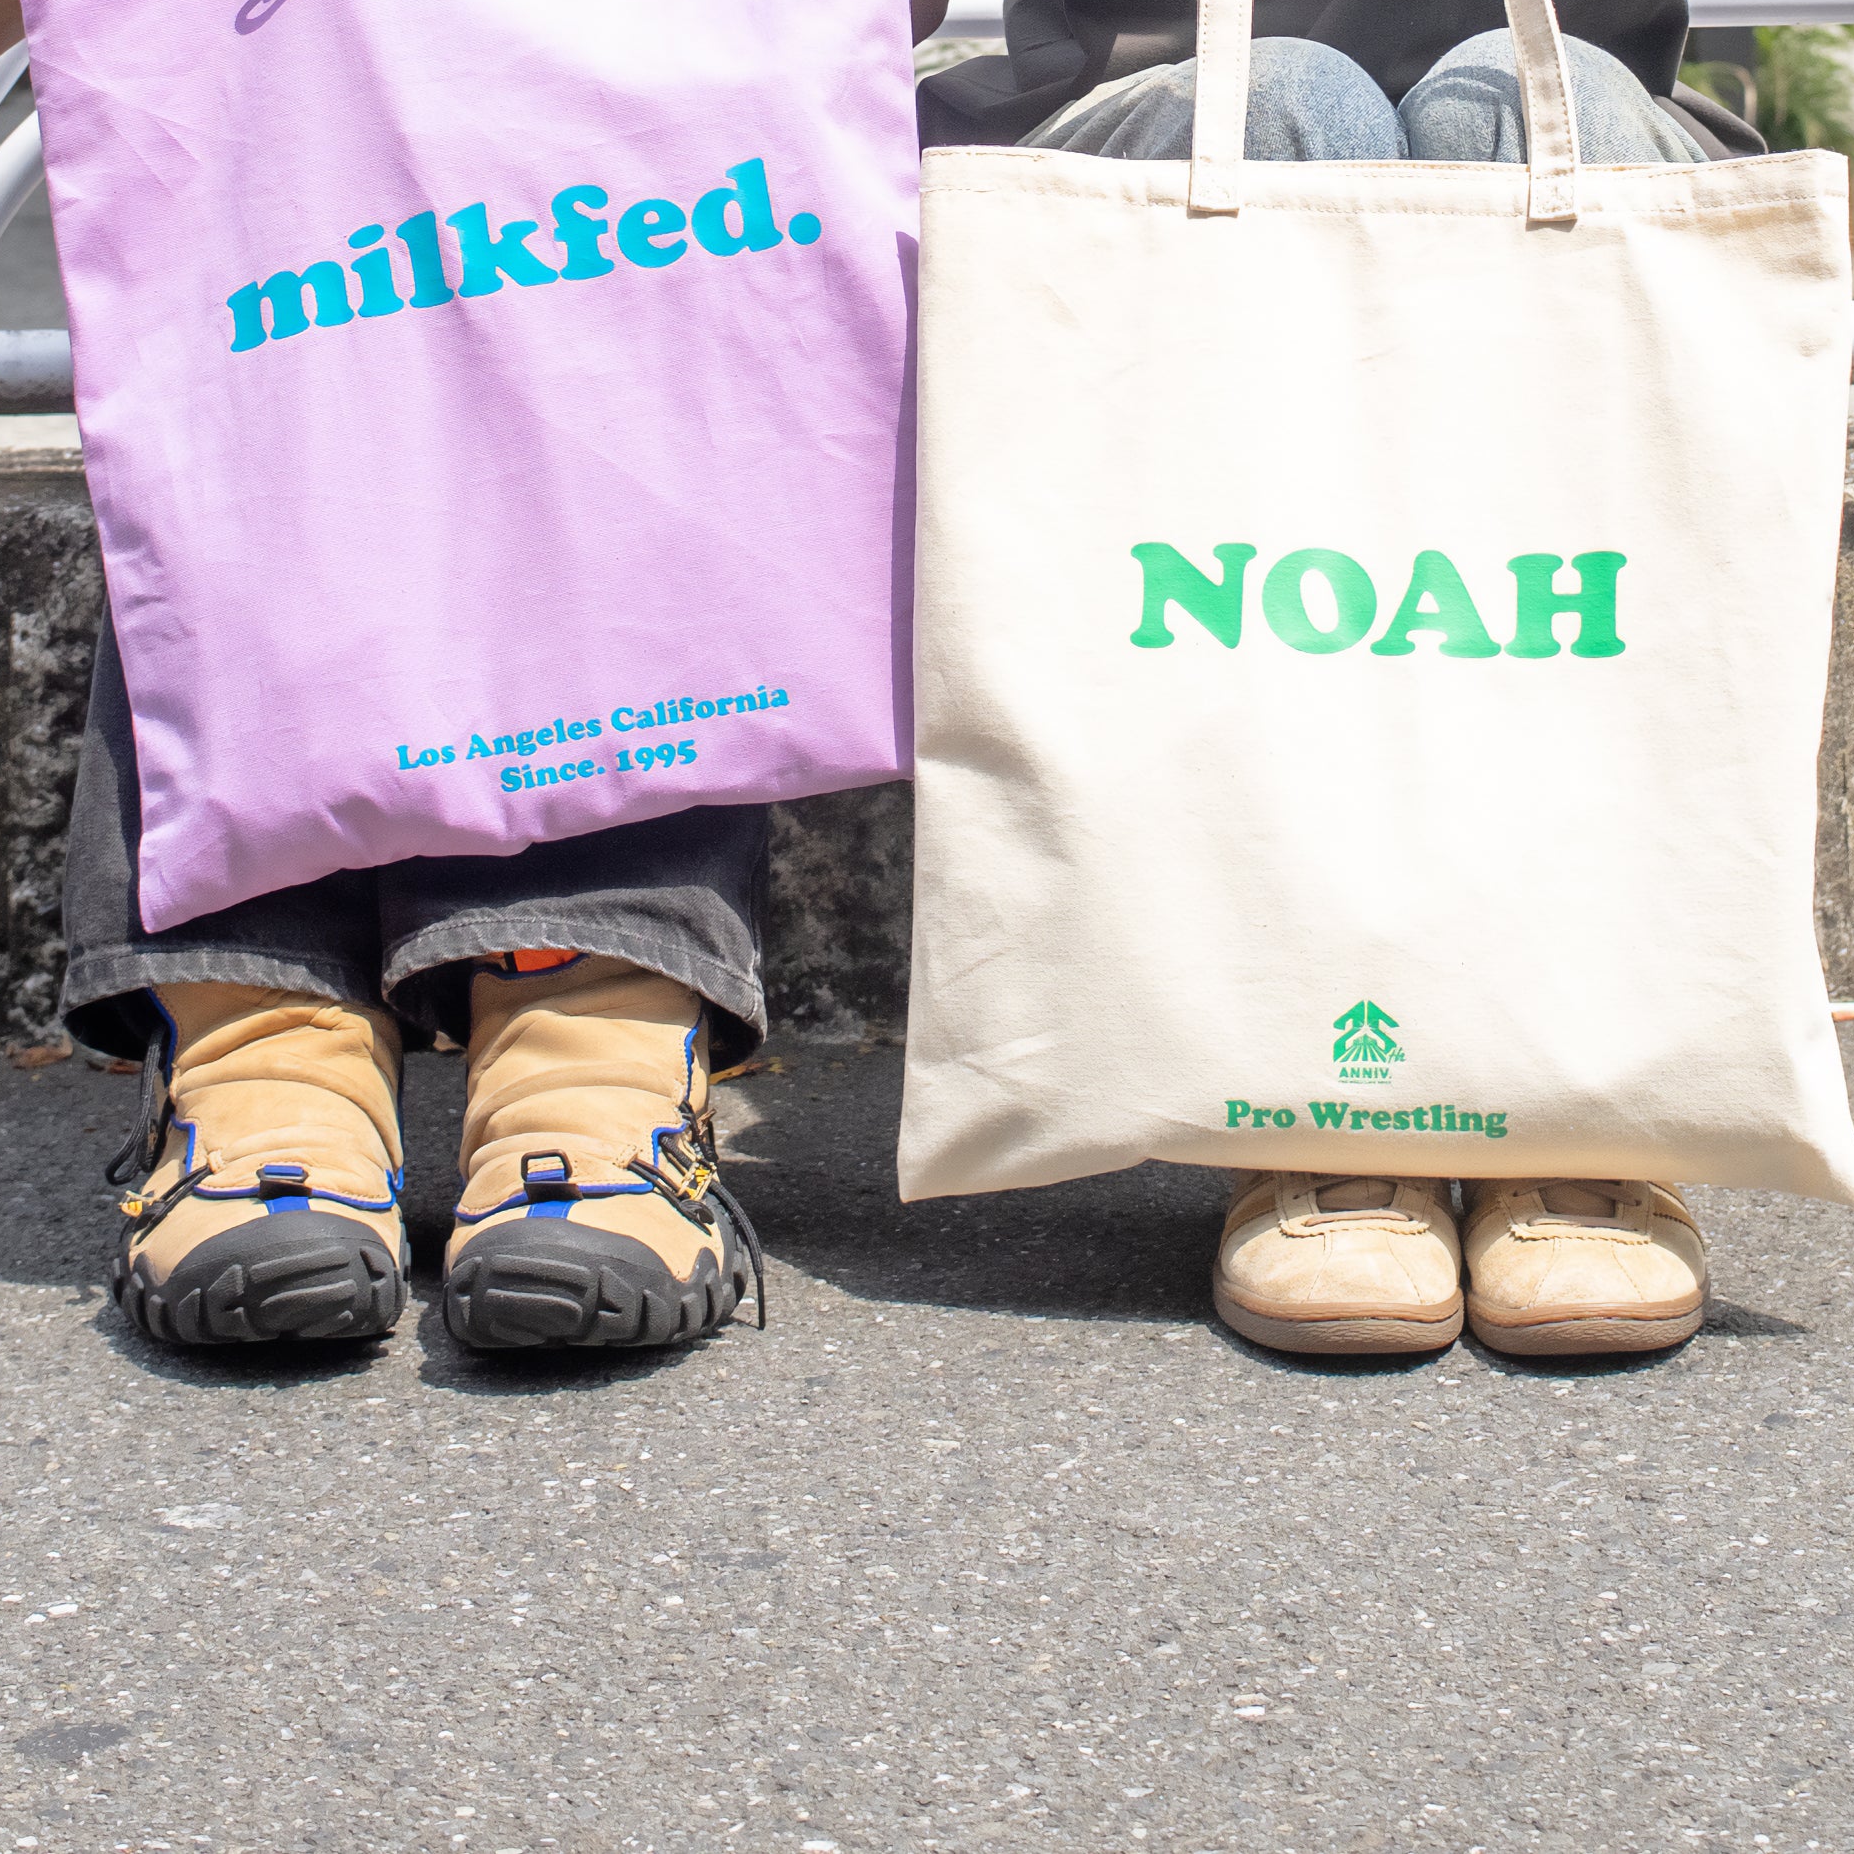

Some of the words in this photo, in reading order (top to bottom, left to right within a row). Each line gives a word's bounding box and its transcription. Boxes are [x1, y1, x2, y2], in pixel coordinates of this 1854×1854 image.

[226, 158, 822, 353] milkfed.
[1129, 542, 1628, 659] NOAH
[396, 744, 456, 771] Los
[465, 718, 603, 761] Angeles
[610, 684, 790, 733] California
[499, 758, 606, 793] Since.
[615, 738, 698, 773] 1995
[1339, 1067, 1392, 1079] ANNIV.
[1226, 1100, 1296, 1128] Pro
[1308, 1102, 1508, 1139] Wrestling
